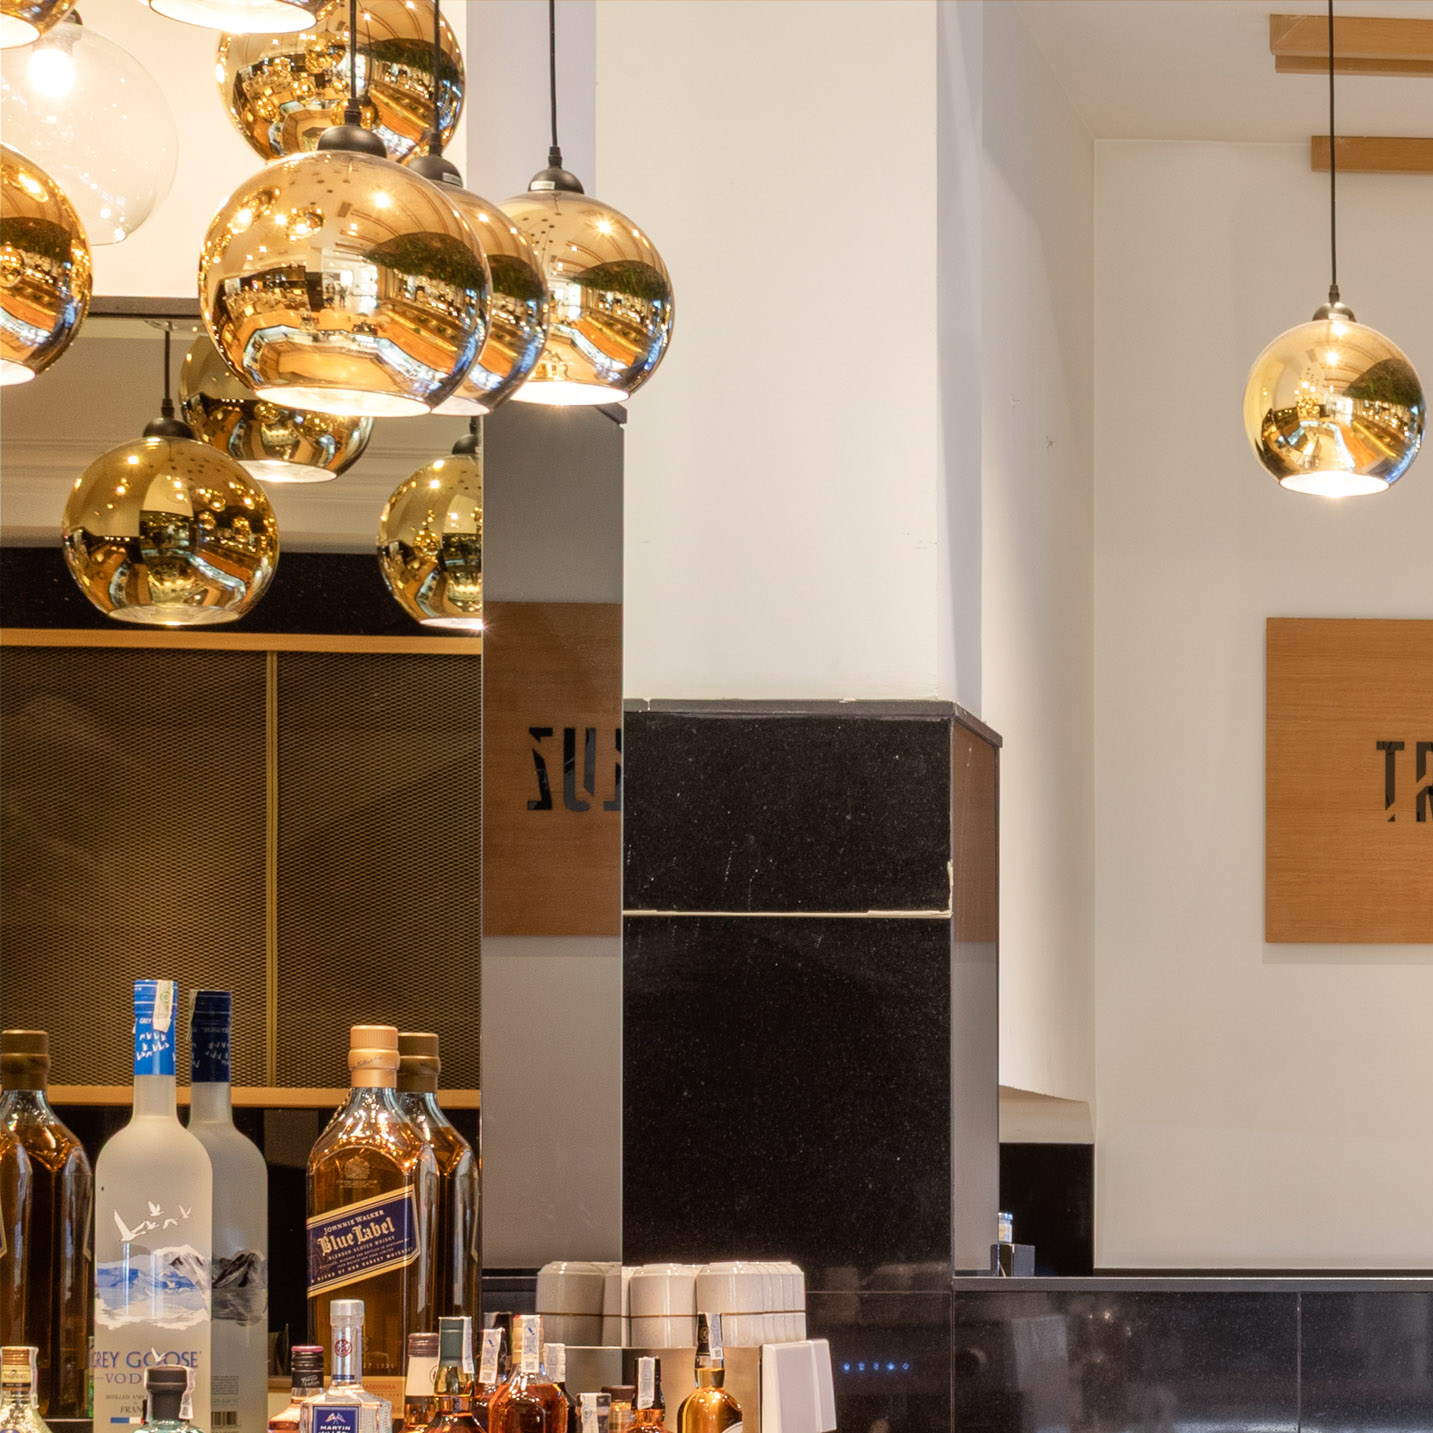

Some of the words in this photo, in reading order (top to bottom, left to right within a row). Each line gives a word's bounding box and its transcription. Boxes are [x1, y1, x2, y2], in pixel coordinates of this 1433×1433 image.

[323, 1220, 355, 1235] JOHNNIE
[355, 1209, 385, 1224] WALKER
[316, 1232, 355, 1257] Blue
[351, 1216, 396, 1245] Label
[126, 1351, 198, 1368] GOOSE
[105, 1373, 142, 1385] VOD
[120, 1405, 142, 1414] FRAN
